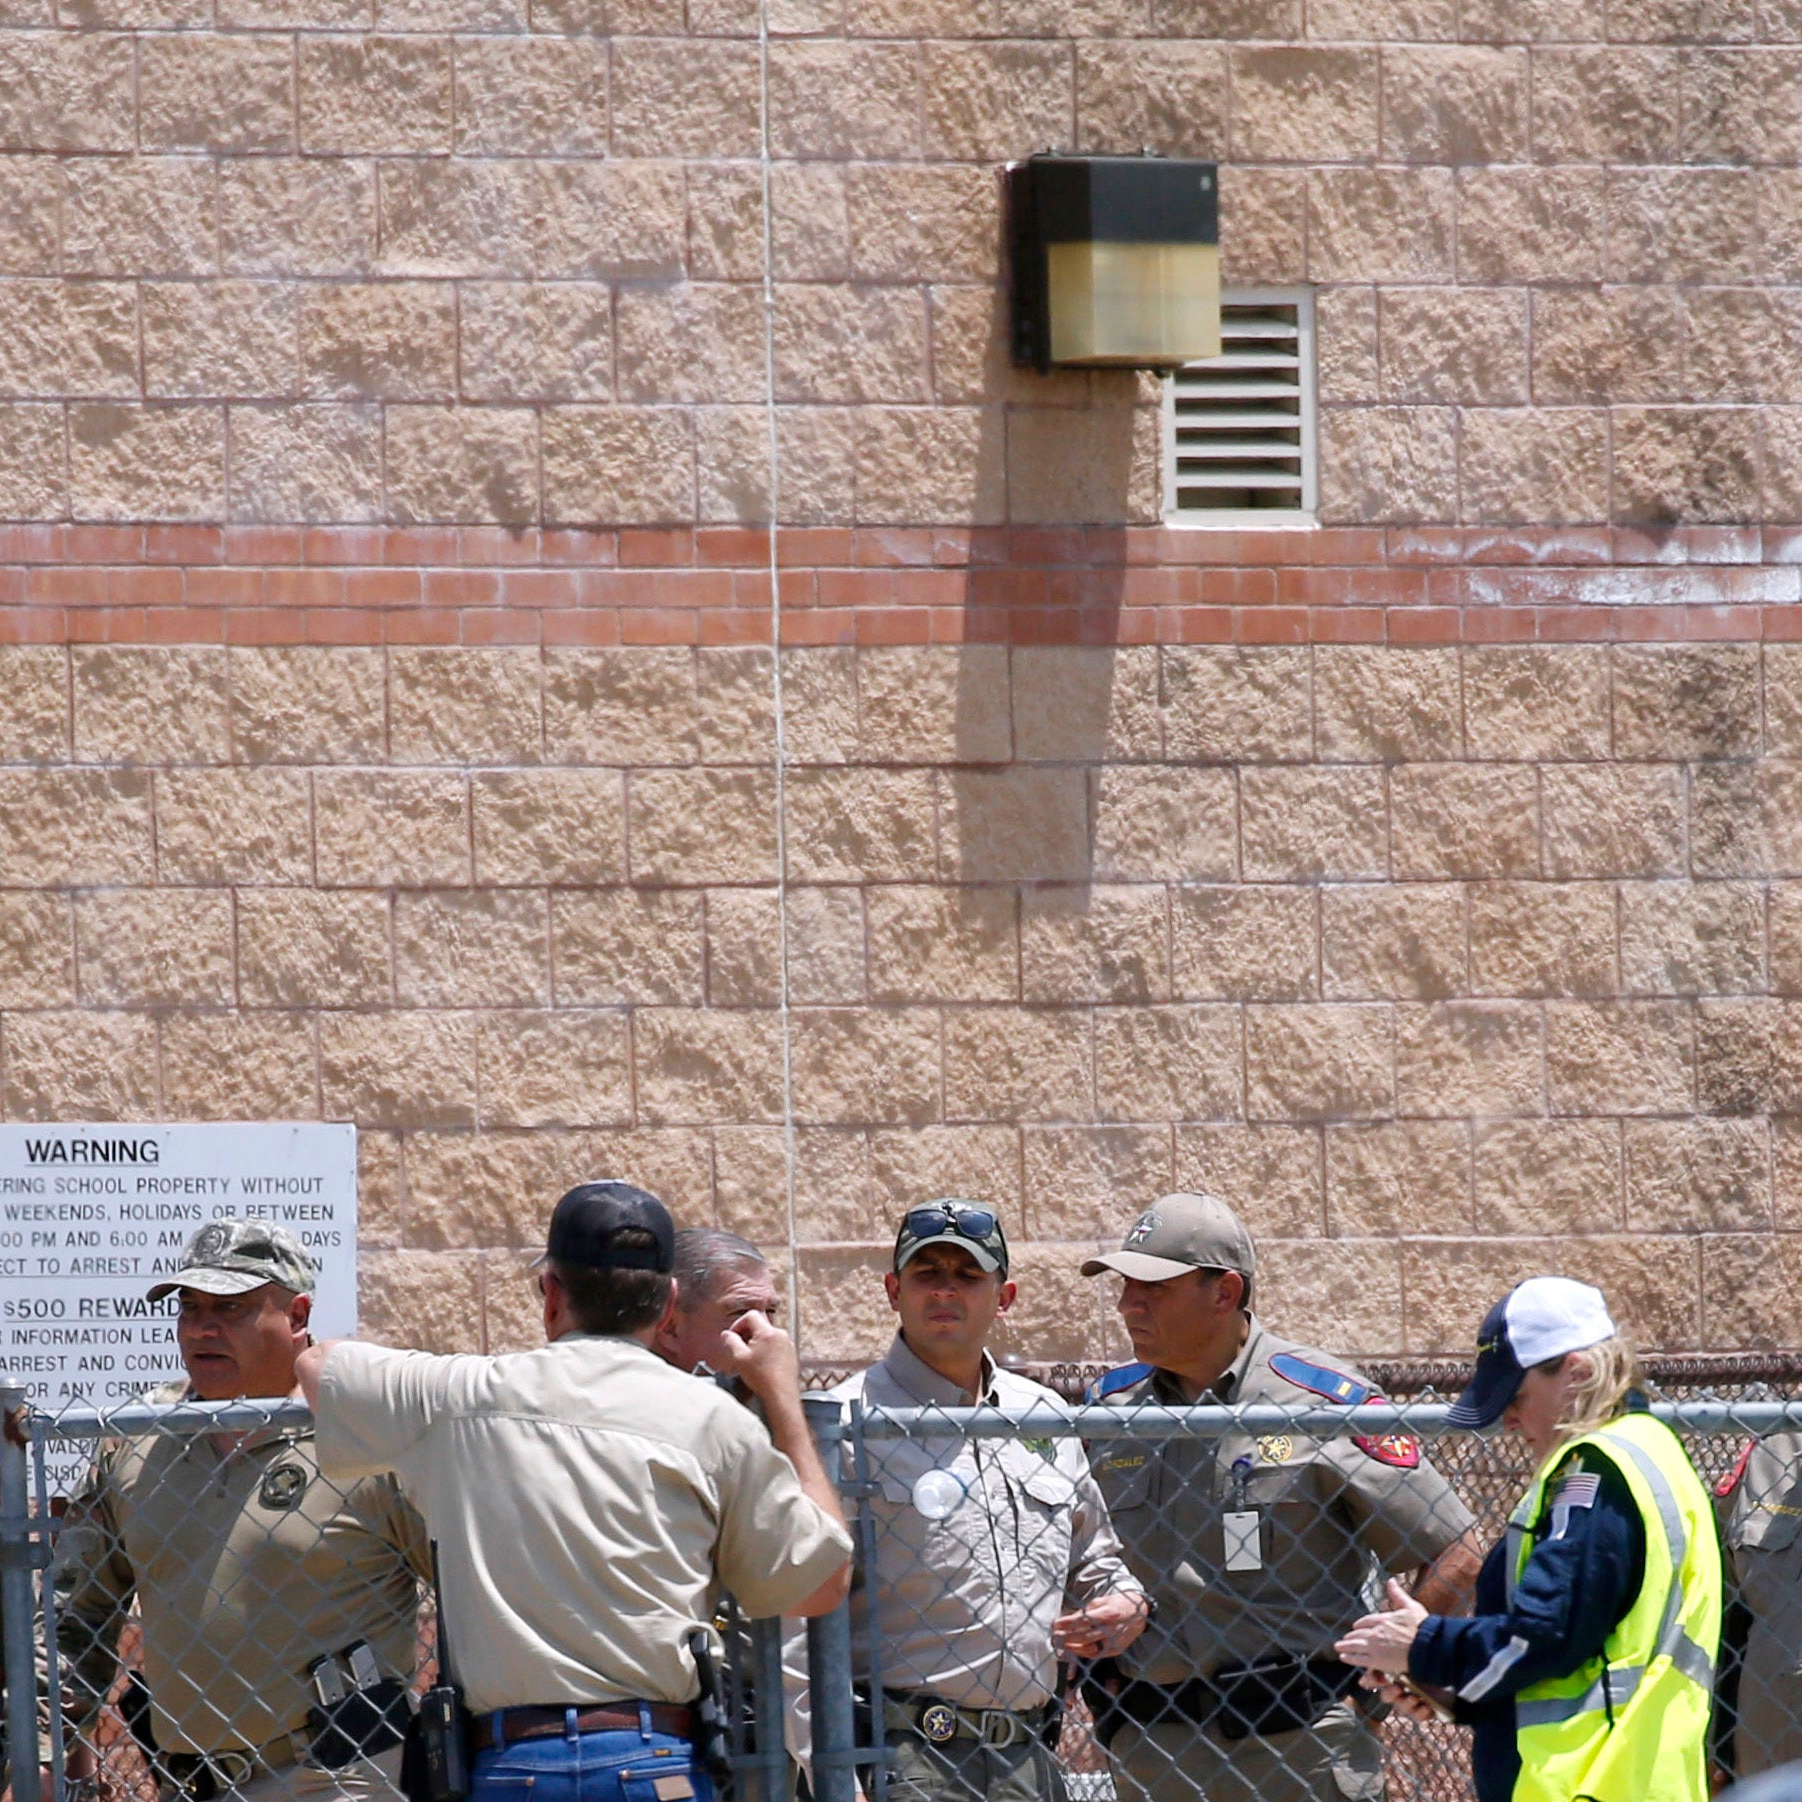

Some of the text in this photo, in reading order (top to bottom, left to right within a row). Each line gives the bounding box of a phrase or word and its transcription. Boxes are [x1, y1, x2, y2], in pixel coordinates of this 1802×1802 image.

[26, 1139, 159, 1163] WARNING
[54, 1177, 127, 1194] SCHOOL
[137, 1177, 230, 1193] PROPERTY
[241, 1177, 324, 1193] WITHOUT
[5, 1204, 111, 1222] WEEKENDS,
[120, 1204, 202, 1220] HOLIDAYS
[212, 1204, 236, 1220] OR
[246, 1204, 334, 1221] BETWEEN
[32, 1231, 57, 1247] PM
[65, 1231, 101, 1247] AND
[110, 1231, 148, 1247] 6:00
[157, 1231, 183, 1247] AM
[301, 1231, 341, 1247] DAYS
[38, 1258, 61, 1274] TO
[70, 1258, 141, 1274] ARREST
[4, 1298, 181, 1318] $500 REWARD
[11, 1328, 133, 1345] INFORMATION
[78, 1355, 115, 1371] AND
[59, 1382, 95, 1398] ANY
